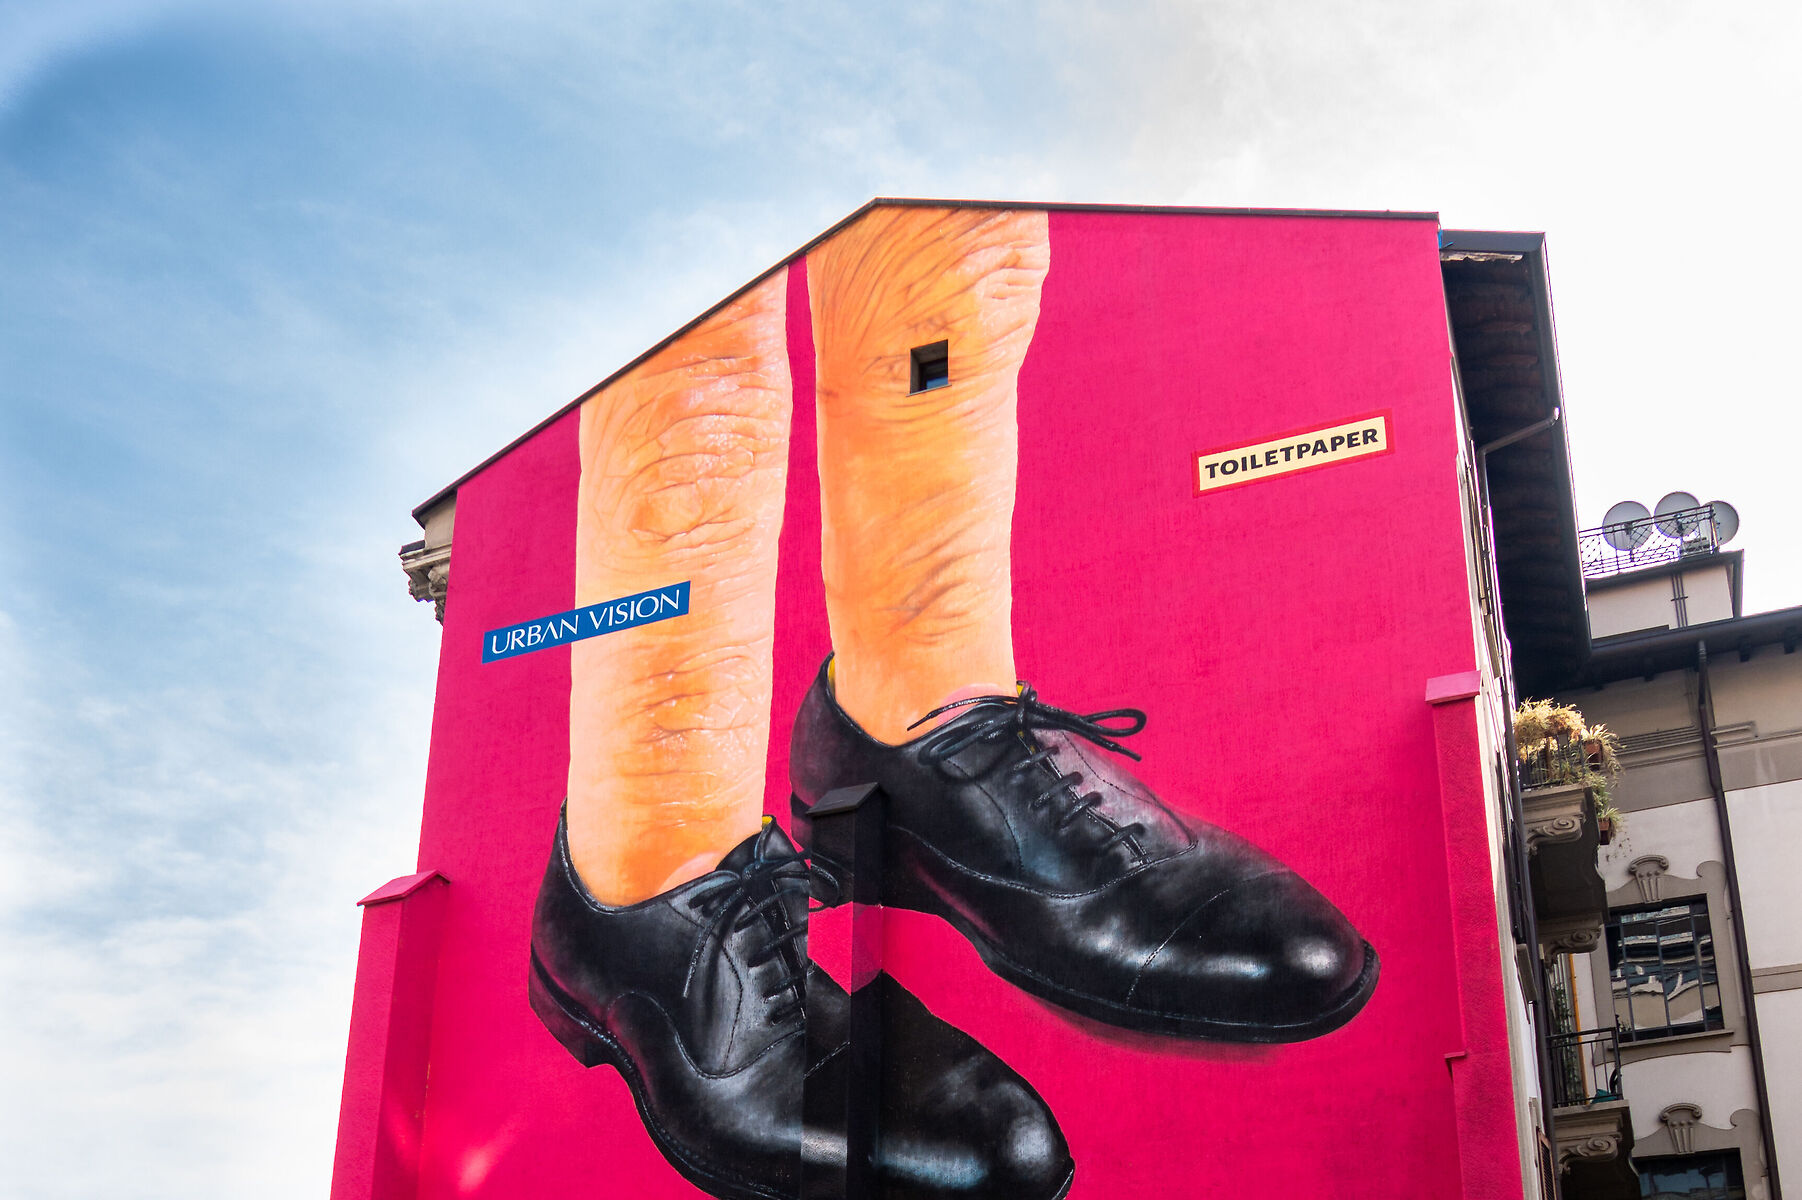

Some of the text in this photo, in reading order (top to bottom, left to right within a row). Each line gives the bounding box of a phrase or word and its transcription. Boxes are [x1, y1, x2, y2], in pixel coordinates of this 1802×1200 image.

[1205, 428, 1379, 479] TOILETPAPER
[491, 589, 680, 654] URBAN VISION
